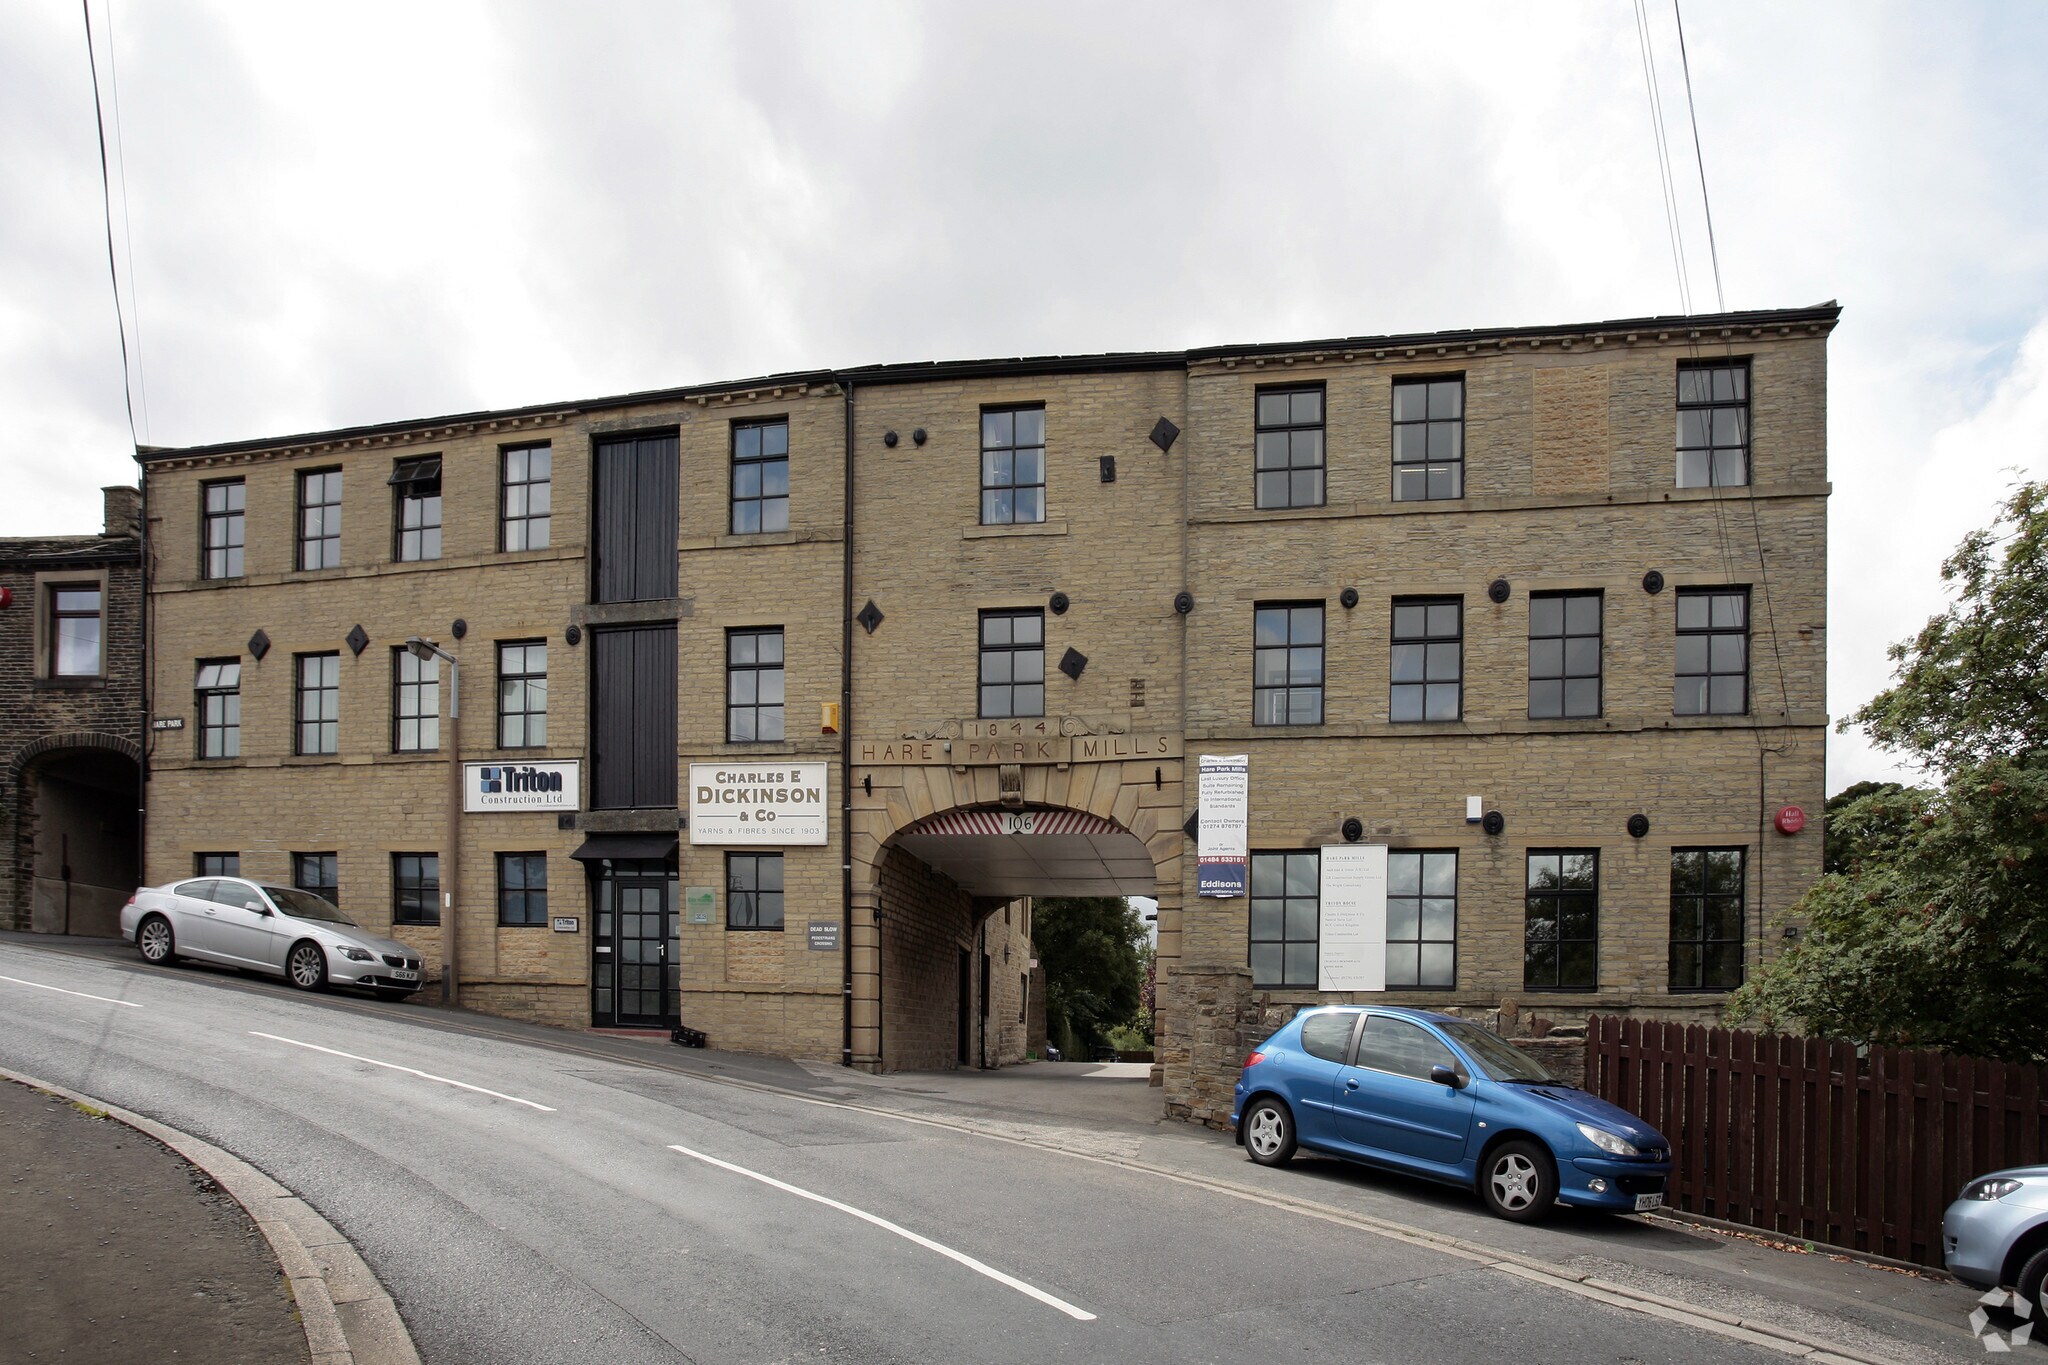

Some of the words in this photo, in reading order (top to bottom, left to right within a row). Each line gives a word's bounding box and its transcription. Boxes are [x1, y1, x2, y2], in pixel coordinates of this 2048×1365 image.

[167, 719, 182, 728] PARK
[974, 722, 1046, 737] 1844
[862, 744, 932, 760] HARE
[969, 741, 1050, 760] PARK
[1084, 735, 1168, 758] MILLS
[503, 766, 562, 792] Triton
[791, 770, 801, 783] E
[481, 794, 542, 804] Construction
[546, 793, 562, 803] Ltd
[739, 811, 749, 822] &
[1008, 816, 1032, 831] 106
[1201, 880, 1242, 888] Eddisons
